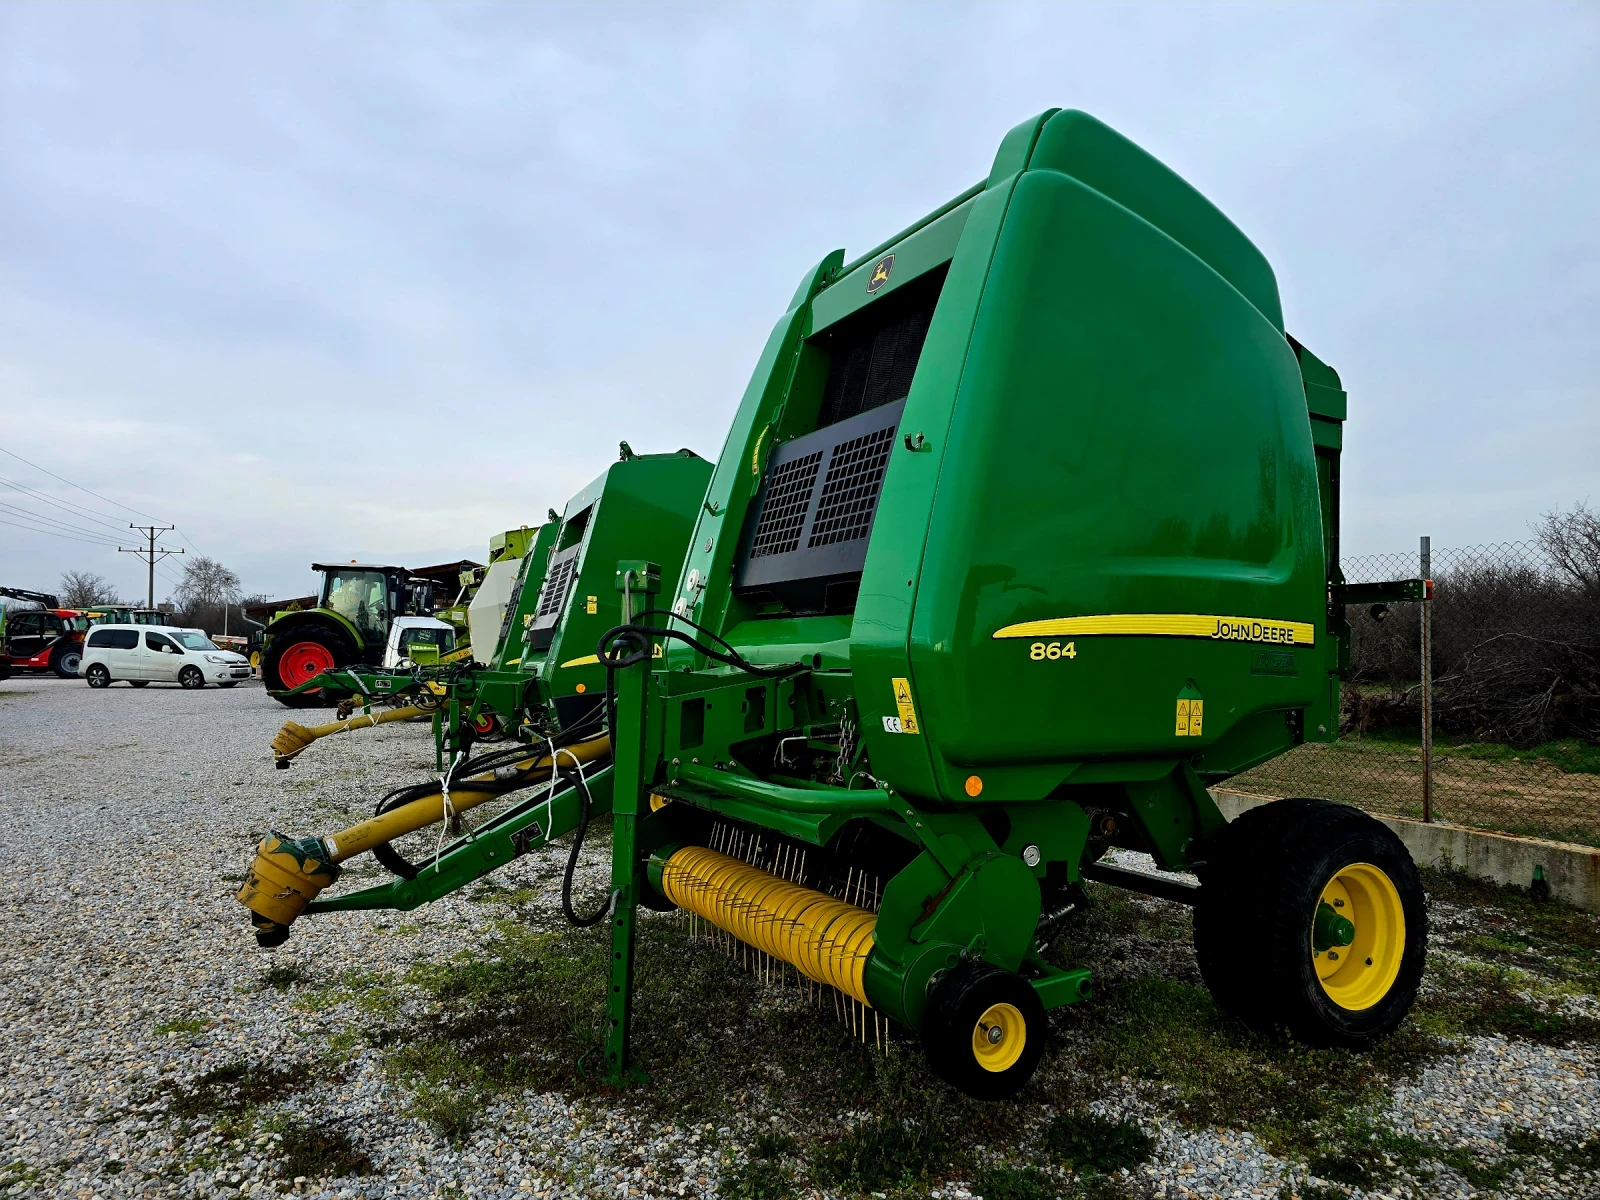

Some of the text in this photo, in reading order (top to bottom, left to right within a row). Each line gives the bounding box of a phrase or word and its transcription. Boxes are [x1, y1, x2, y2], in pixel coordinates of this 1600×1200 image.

[1211, 620, 1294, 642] JOHN DEERE
[1030, 641, 1077, 661] 864
